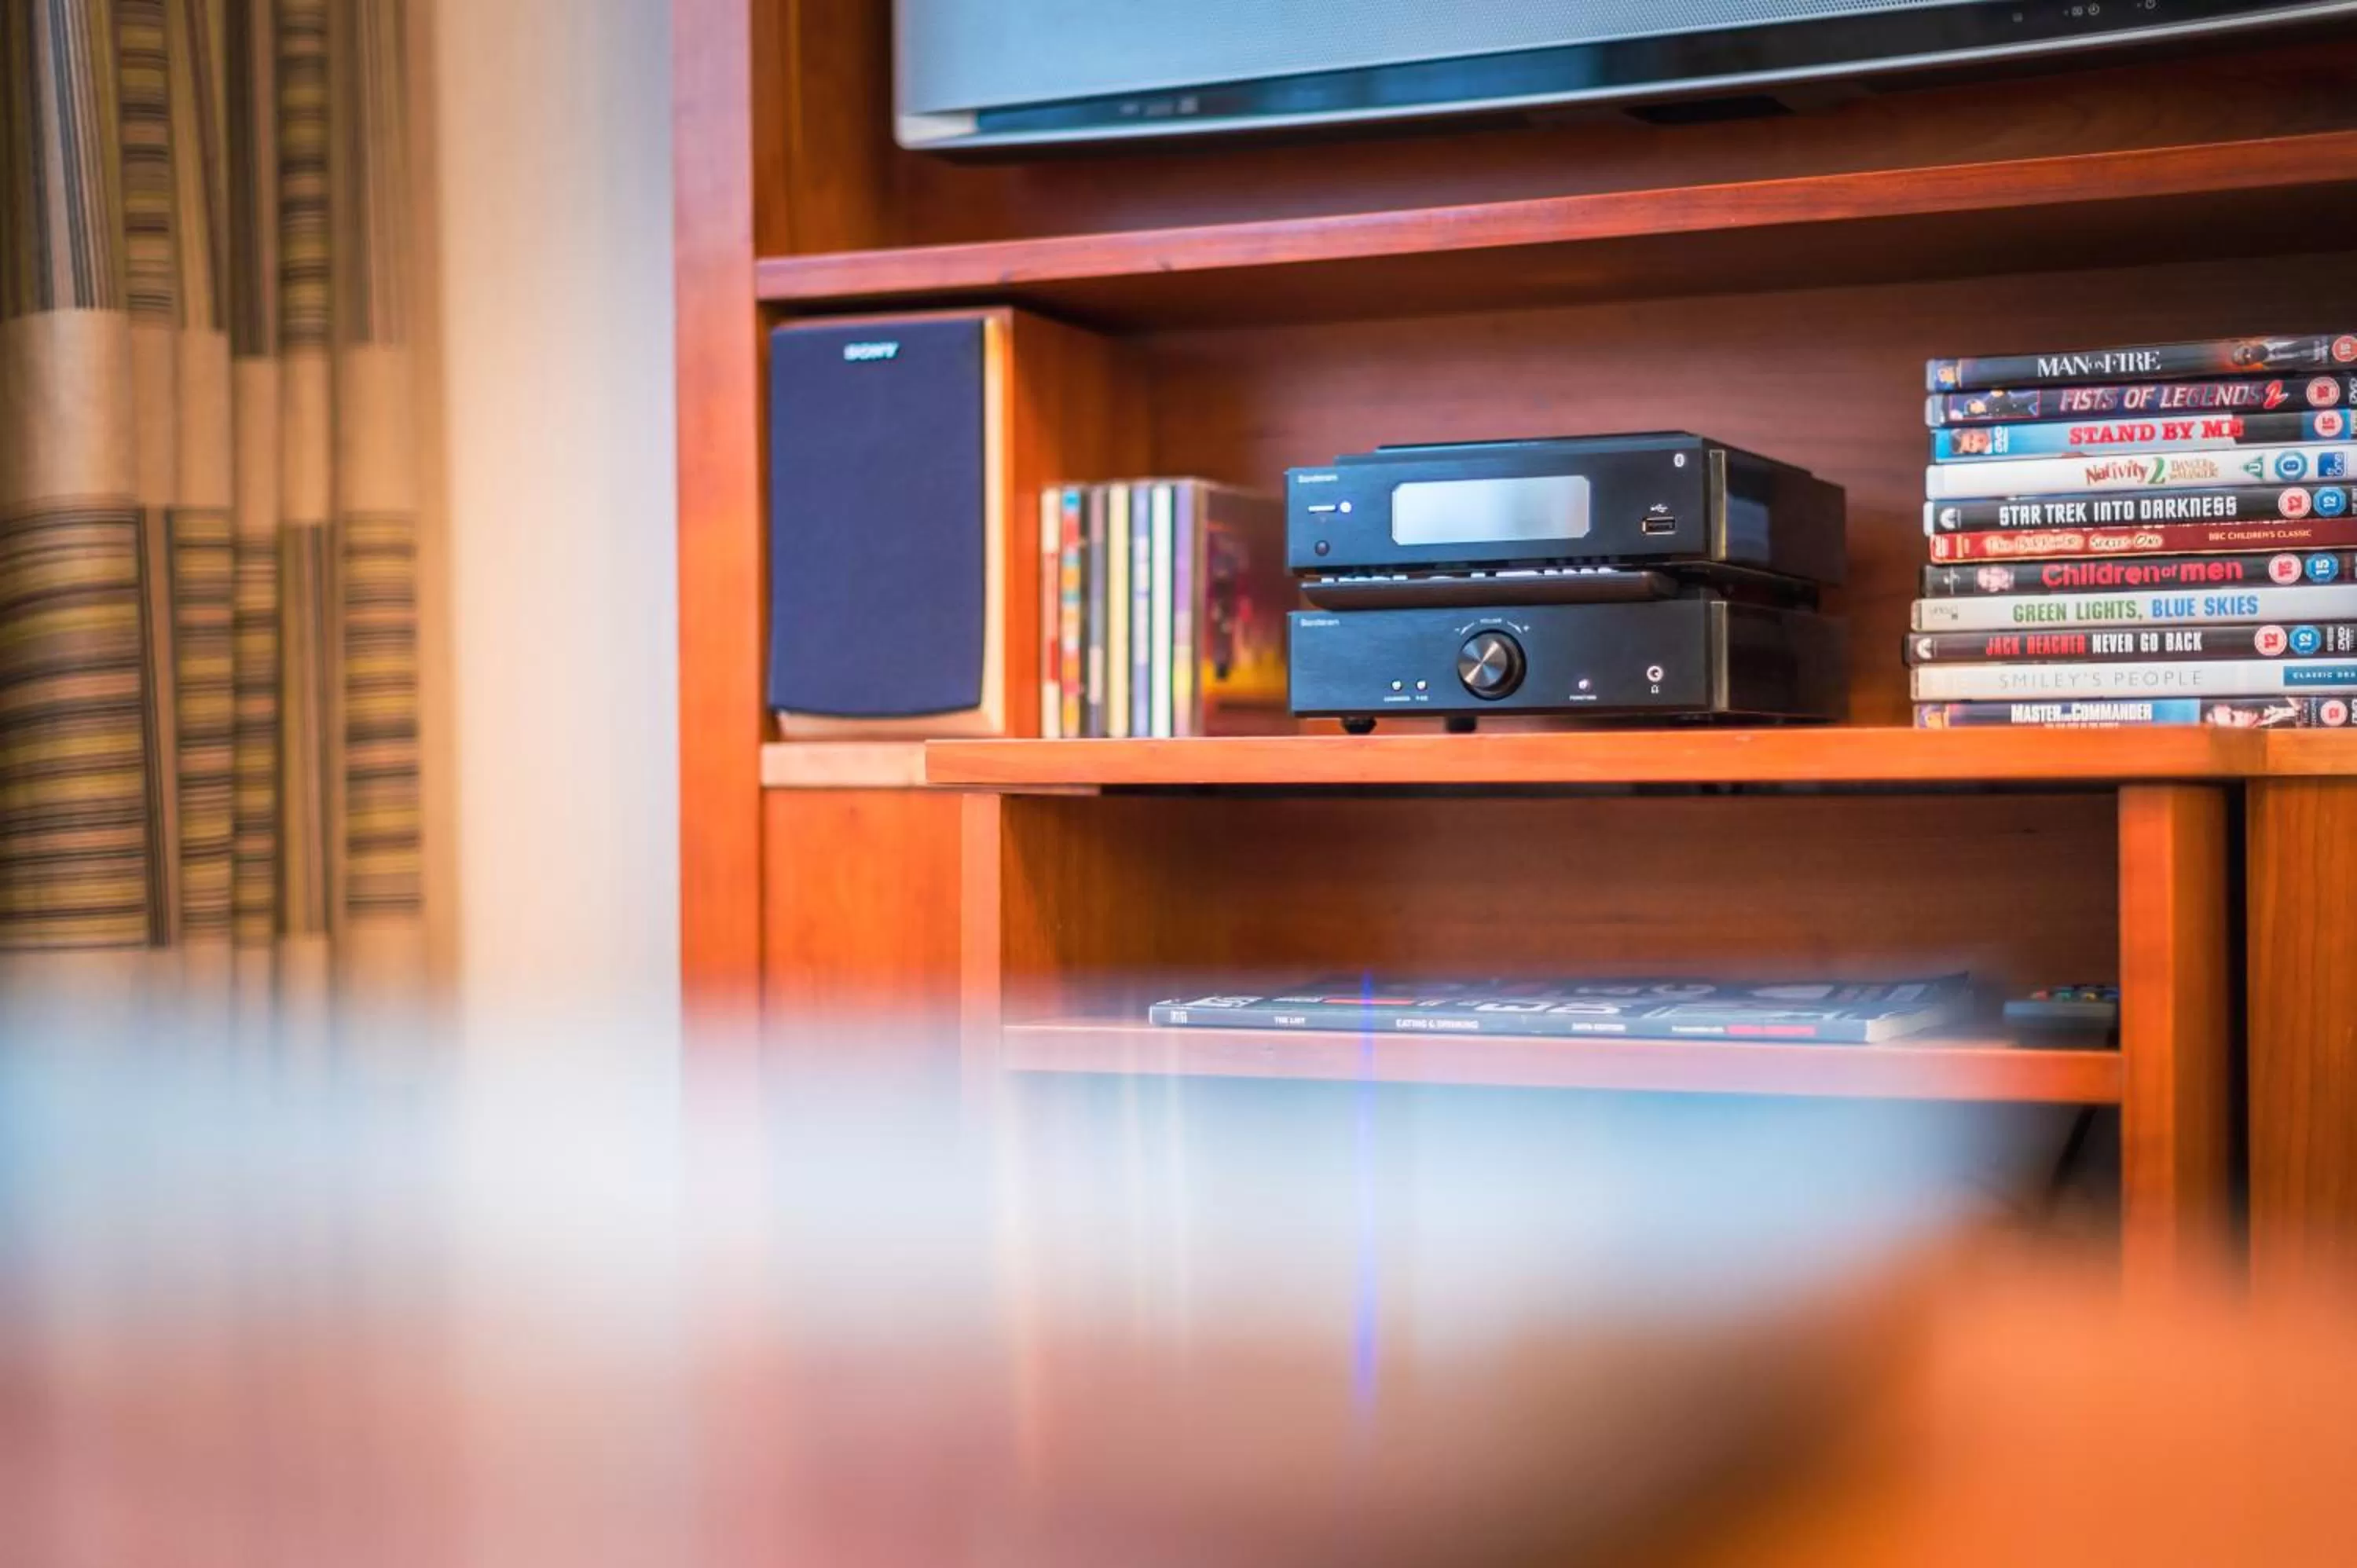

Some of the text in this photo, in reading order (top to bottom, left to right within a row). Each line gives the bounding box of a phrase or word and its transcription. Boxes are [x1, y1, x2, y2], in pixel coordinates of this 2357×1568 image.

[843, 341, 899, 361] SONY
[2037, 355, 2088, 377] MAN
[2105, 351, 2161, 373] FIRE
[2060, 380, 2288, 411] FISTS OF LEGENDS 2
[2069, 417, 2245, 445] STAND BY ME
[2085, 457, 2166, 485] Nativity 2
[1999, 496, 2238, 526] STAR TREK INTO DARKNESS
[2322, 495, 2337, 508] 12
[2209, 529, 2312, 540] BBC CHILDREN'S CLASSIC
[2042, 561, 2243, 588] Children of men
[2315, 558, 2330, 576] 15
[2013, 595, 2259, 622] GREEN LIGHTS, BLUE SKIES
[1986, 632, 2202, 655] JACK REACHER NEVER GO BACK
[2264, 633, 2278, 649] 12
[2298, 632, 2313, 647] 12
[1999, 669, 2202, 689] SMILEY'S PEOPLE
[2011, 704, 2153, 723] MASTER COMMANDER
[1396, 1018, 1427, 1028] EATING
[1436, 1019, 1479, 1029] DRINKING
